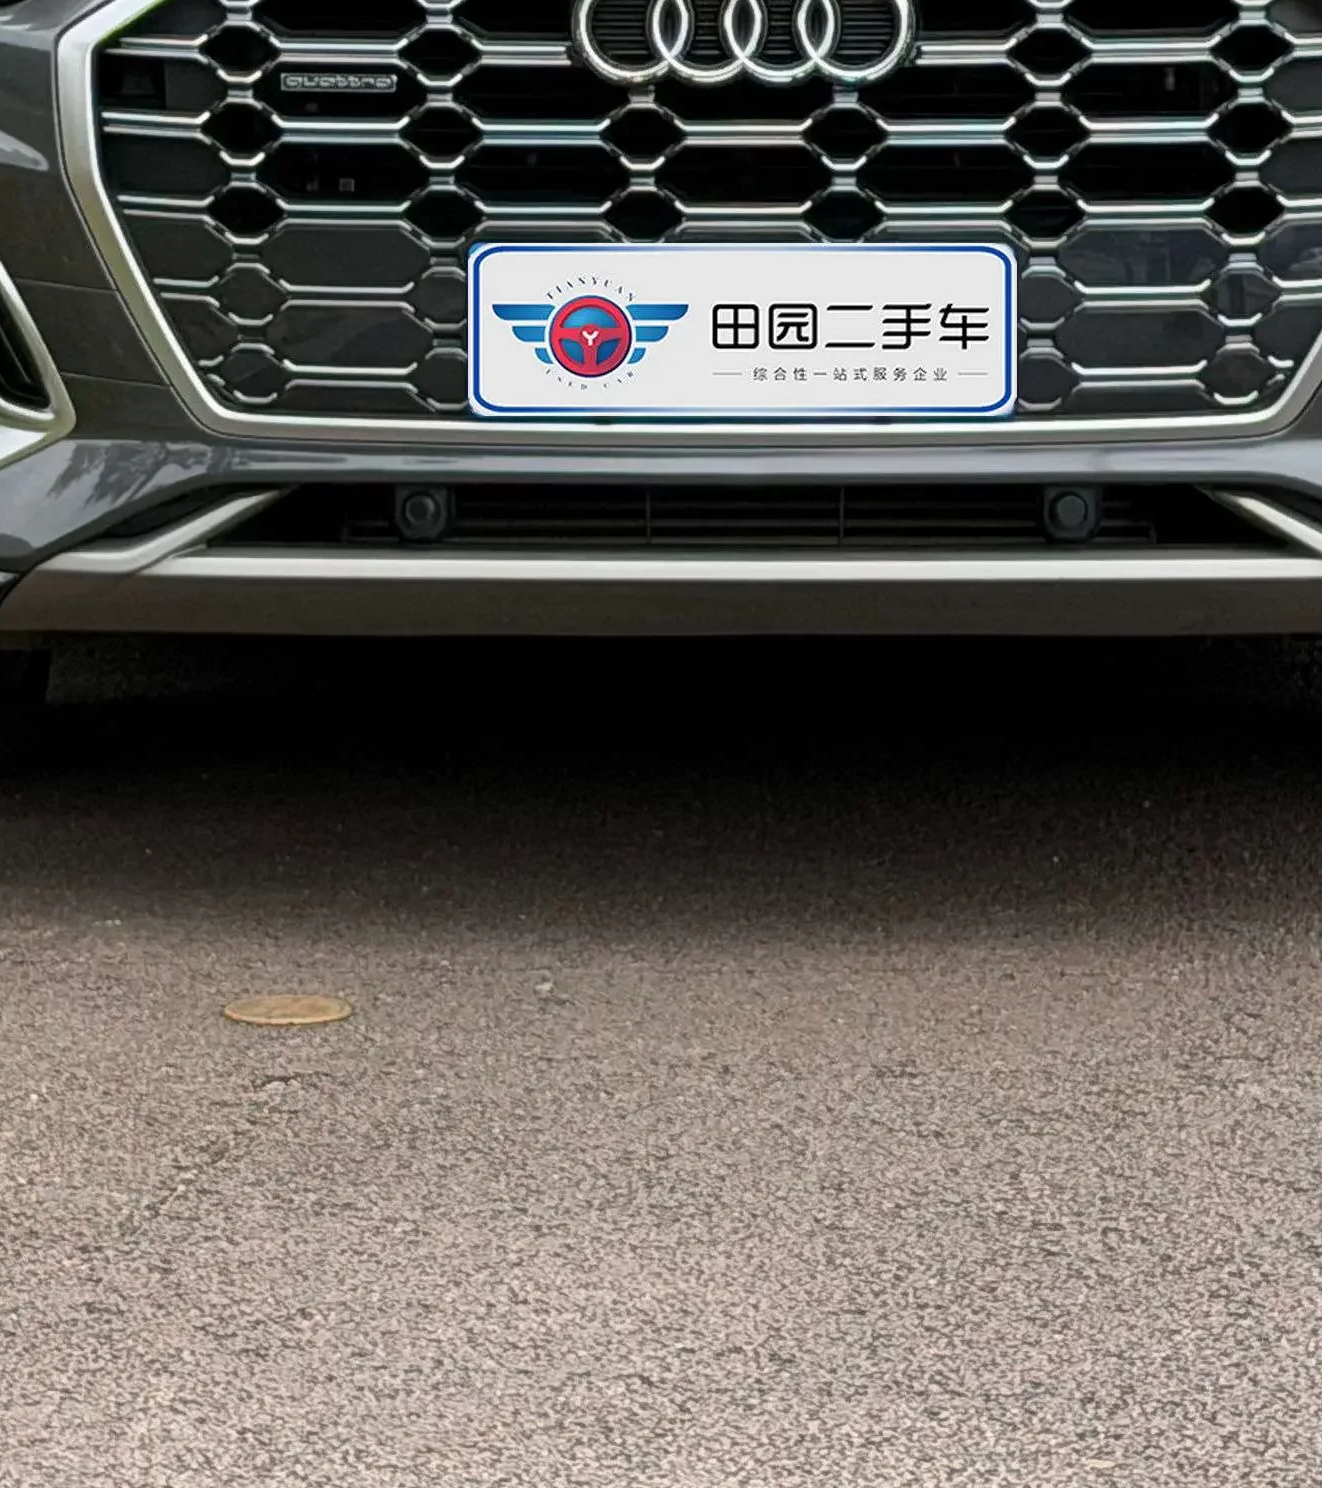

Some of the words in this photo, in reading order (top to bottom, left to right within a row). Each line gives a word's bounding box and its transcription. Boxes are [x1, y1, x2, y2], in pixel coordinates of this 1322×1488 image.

[285, 75, 392, 89] quattro
[712, 303, 990, 350] 田园二手车
[752, 366, 948, 382] 综合性一站式服务企业
